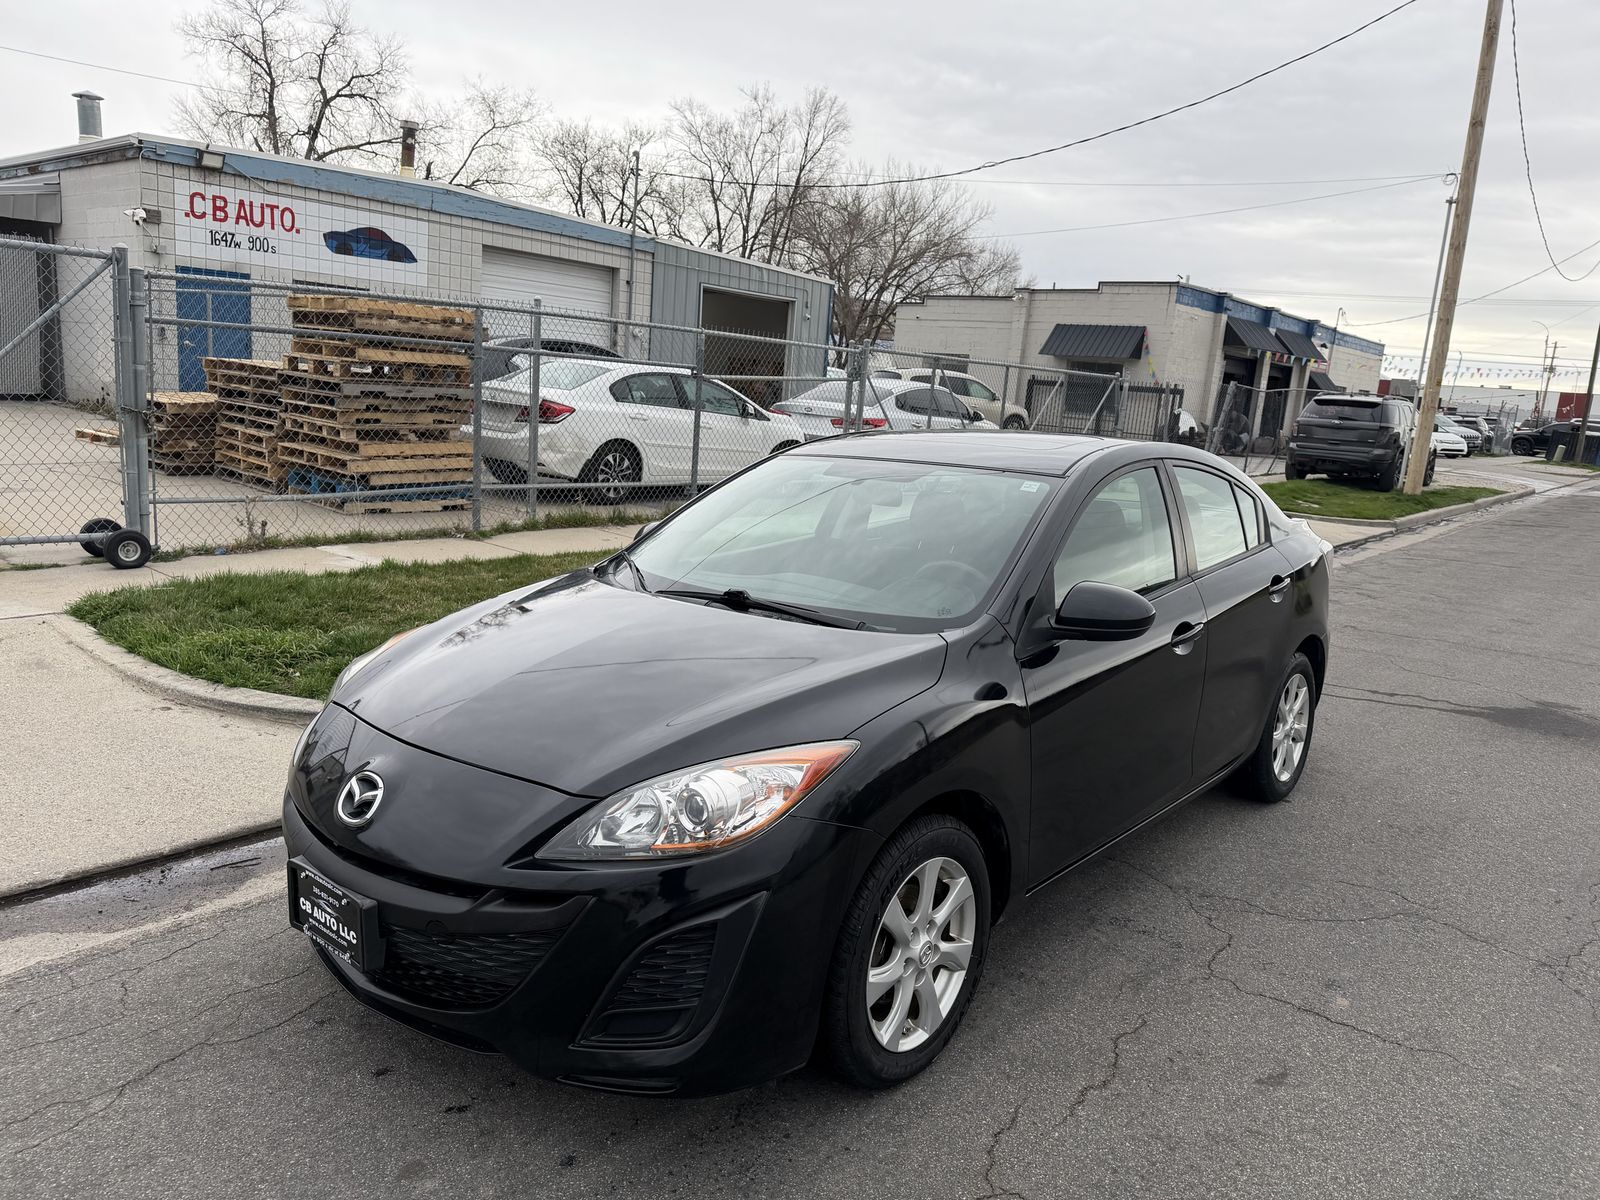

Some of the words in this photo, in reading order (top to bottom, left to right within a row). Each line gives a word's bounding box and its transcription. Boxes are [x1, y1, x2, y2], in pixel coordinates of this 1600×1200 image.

[234, 198, 301, 234] AUTO.
[300, 897, 312, 914] CB
[313, 906, 338, 931] AUTO
[339, 923, 357, 945] LLC
